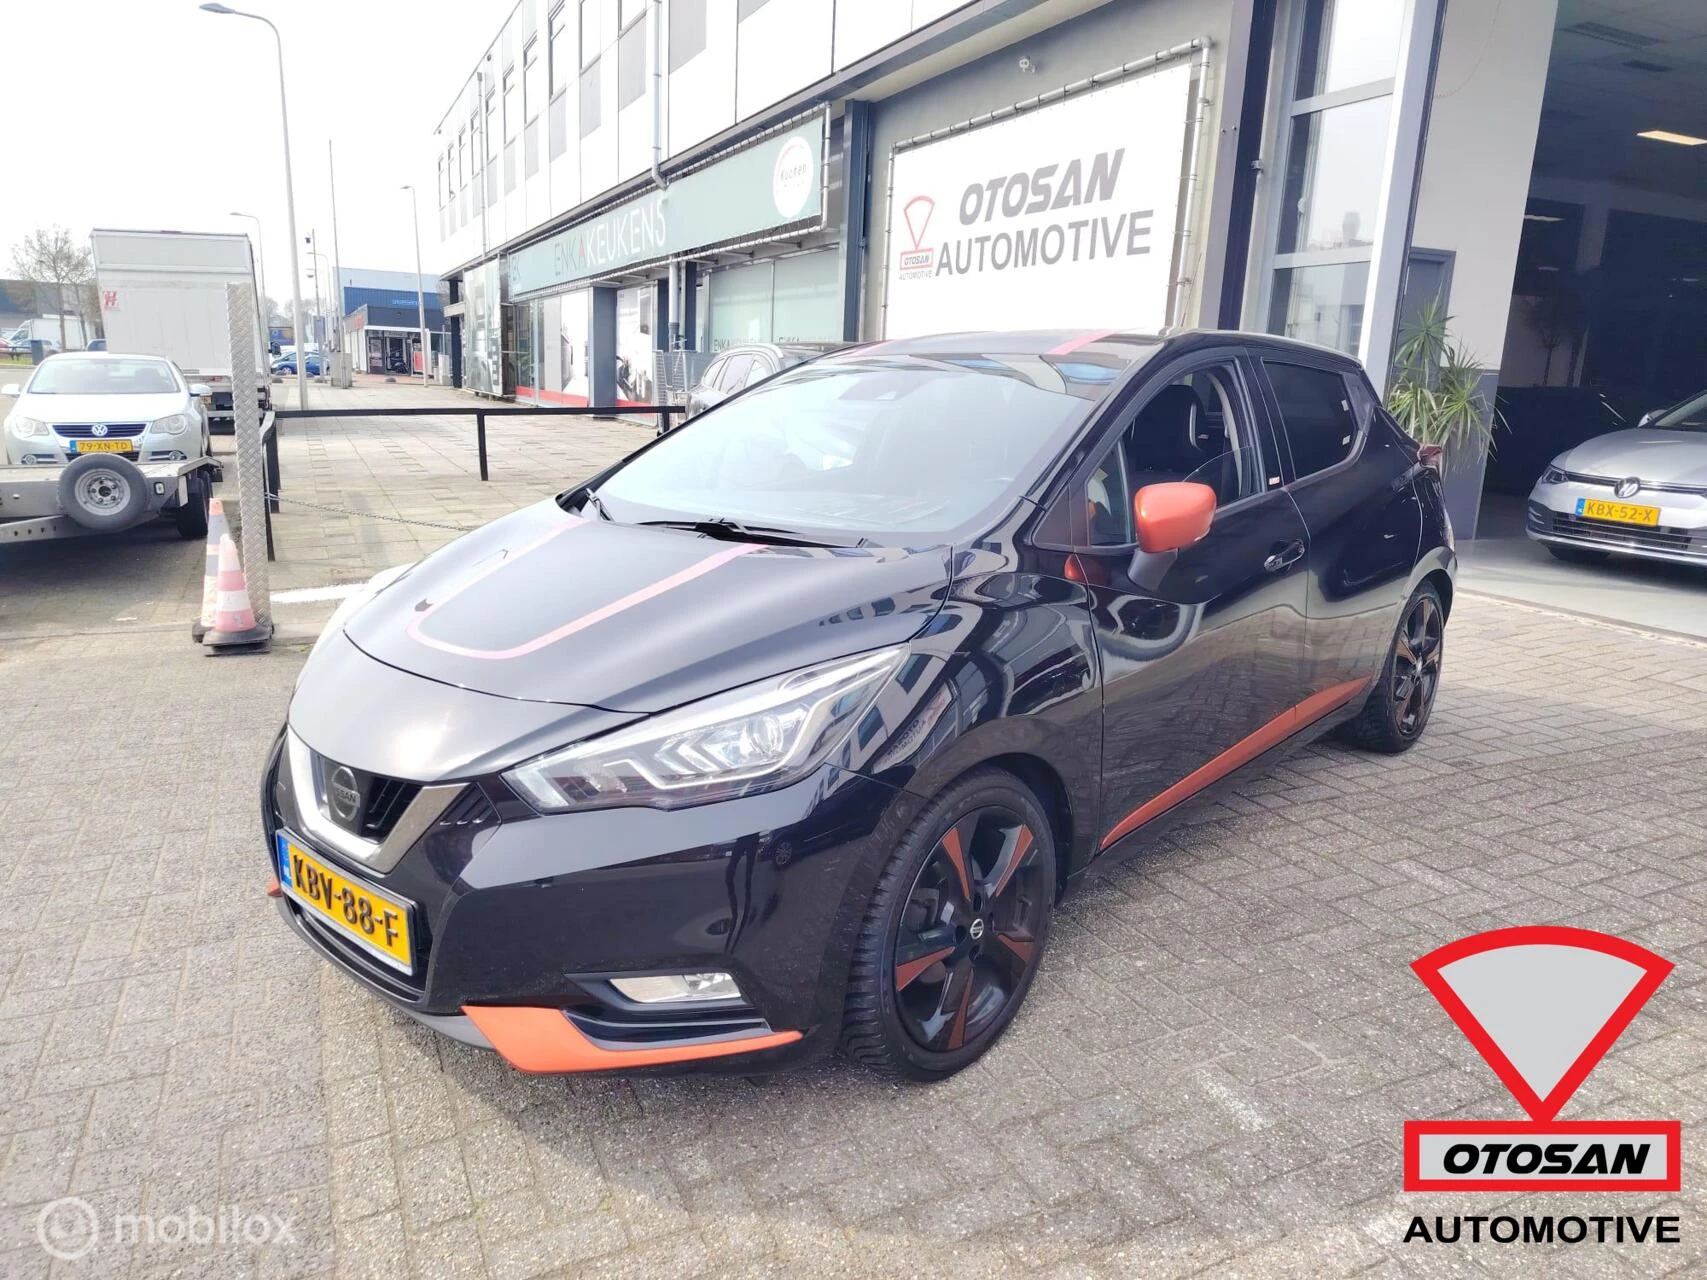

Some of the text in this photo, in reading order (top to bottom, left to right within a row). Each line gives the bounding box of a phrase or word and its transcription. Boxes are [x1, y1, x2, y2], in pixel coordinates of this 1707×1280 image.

[959, 148, 1125, 226] OTOSAN
[904, 255, 930, 266] OTOSAN
[935, 209, 1154, 277] AUTOMOTIVE
[899, 270, 933, 281] AUTOMOTIVE
[1586, 502, 1654, 522] KBX-52-X
[292, 854, 400, 947] KBV-88-F
